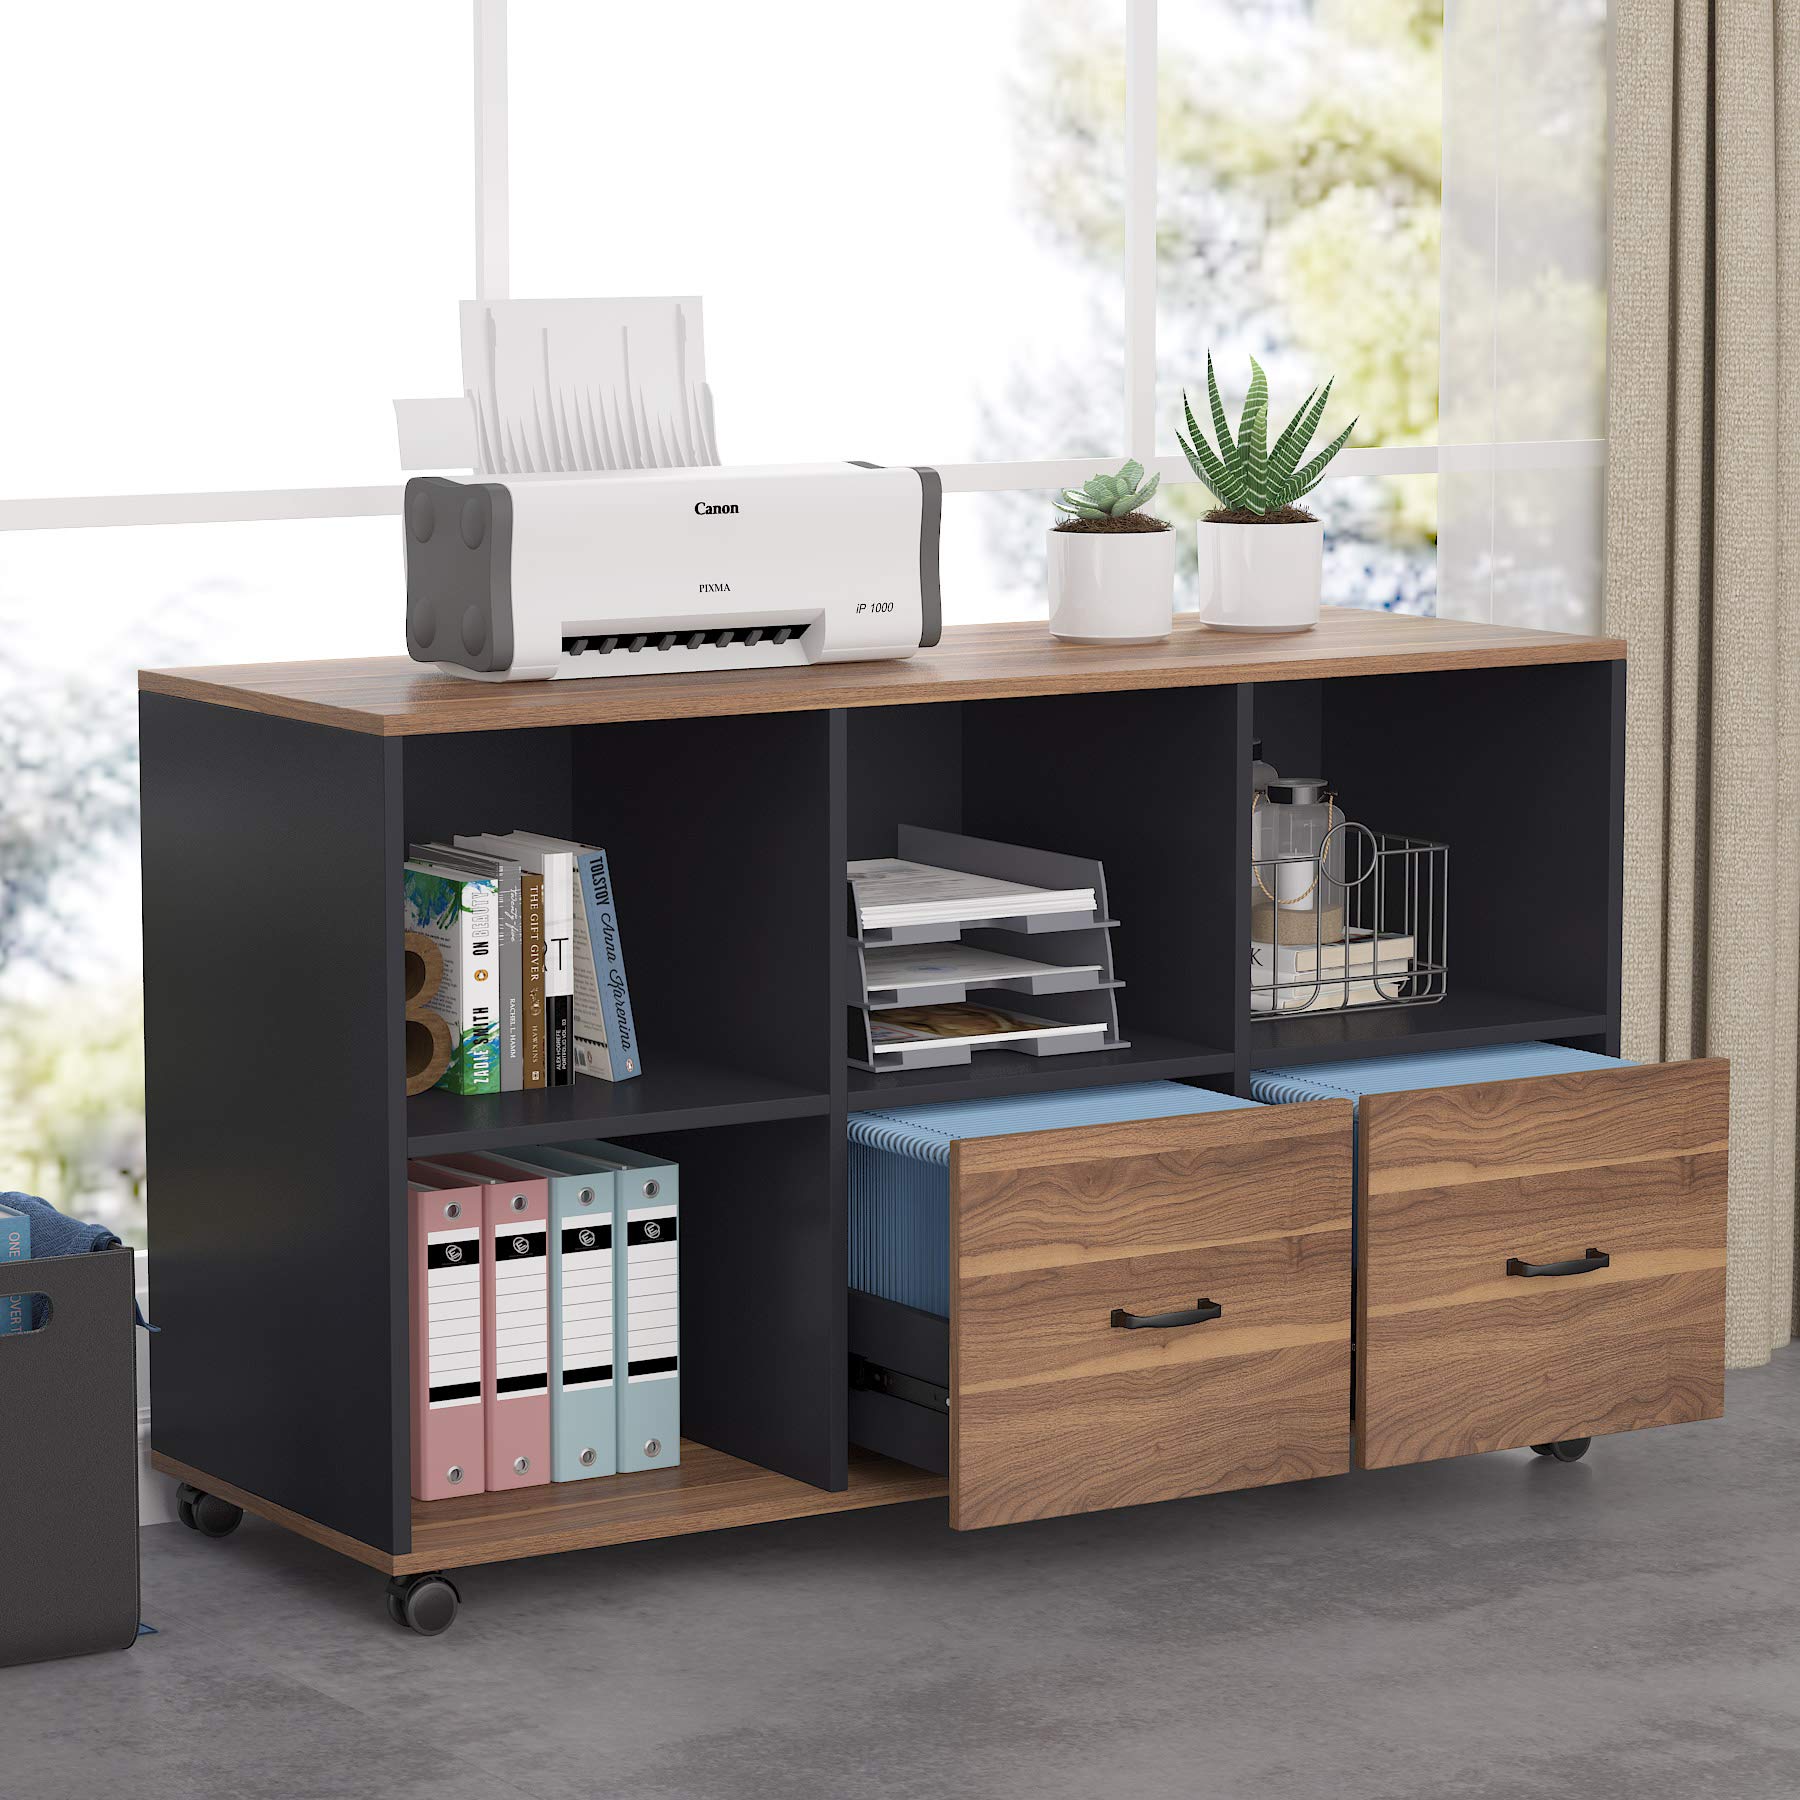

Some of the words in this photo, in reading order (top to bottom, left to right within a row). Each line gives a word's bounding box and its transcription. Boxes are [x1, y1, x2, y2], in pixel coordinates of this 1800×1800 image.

[694, 501, 740, 515] Canon
[699, 583, 731, 593] PIXMA
[871, 602, 894, 613] 1000
[590, 856, 610, 906] TOLSTOY
[530, 885, 539, 909] THE
[472, 892, 489, 938] BEAUTY
[530, 913, 539, 941] GIFT
[472, 941, 489, 956] ON
[600, 912, 617, 963] Anna
[530, 945, 539, 981] GIVER
[607, 968, 632, 1052] Karenina
[472, 1006, 489, 1046] SMITH
[472, 1049, 490, 1084] ZADIE
[8, 1231, 21, 1257] ONE
